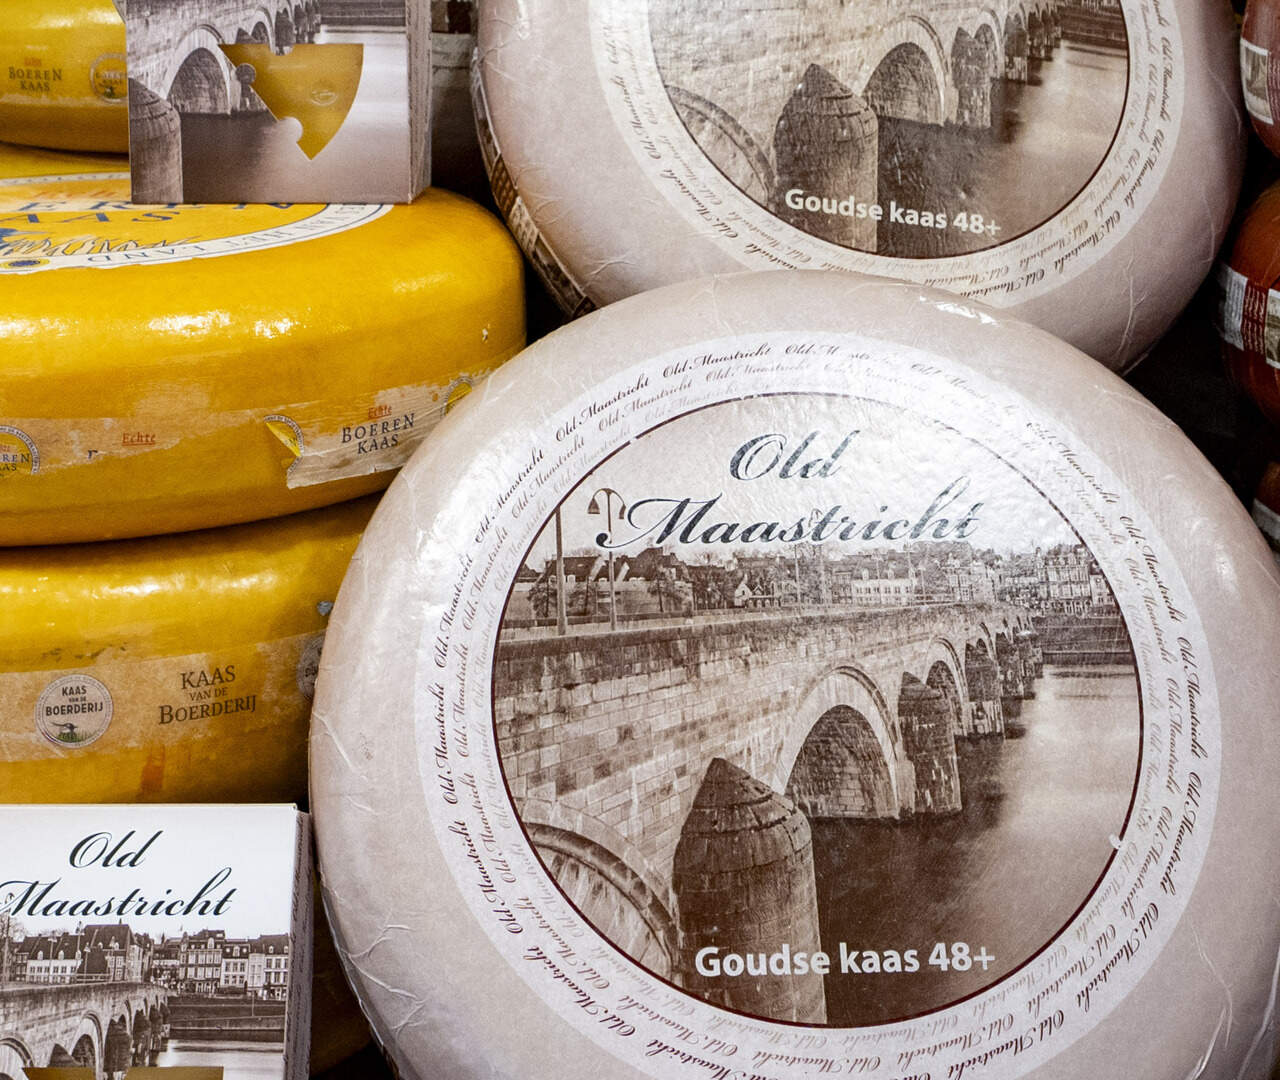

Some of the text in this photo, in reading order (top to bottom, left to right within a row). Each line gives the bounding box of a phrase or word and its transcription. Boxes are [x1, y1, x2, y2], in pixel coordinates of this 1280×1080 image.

[784, 188, 1002, 237] Goudse kaas 48+
[662, 342, 774, 380] Old Maastricht
[368, 405, 393, 419] Echte
[122, 432, 156, 447] Echte
[341, 412, 416, 445] BOEREN
[357, 433, 401, 455] KAAS
[729, 430, 861, 482] Old
[595, 476, 985, 550] Maastricht
[61, 685, 88, 697] KAAS
[180, 664, 237, 691] KAAS
[45, 701, 105, 718] BOERDERIJ
[157, 694, 258, 726] BOERDERIJ
[189, 685, 230, 703] VAN DE
[69, 830, 165, 869] Old
[1159, 803, 1201, 898] Maastricht
[695, 941, 996, 980] Goudse kaas 48+
